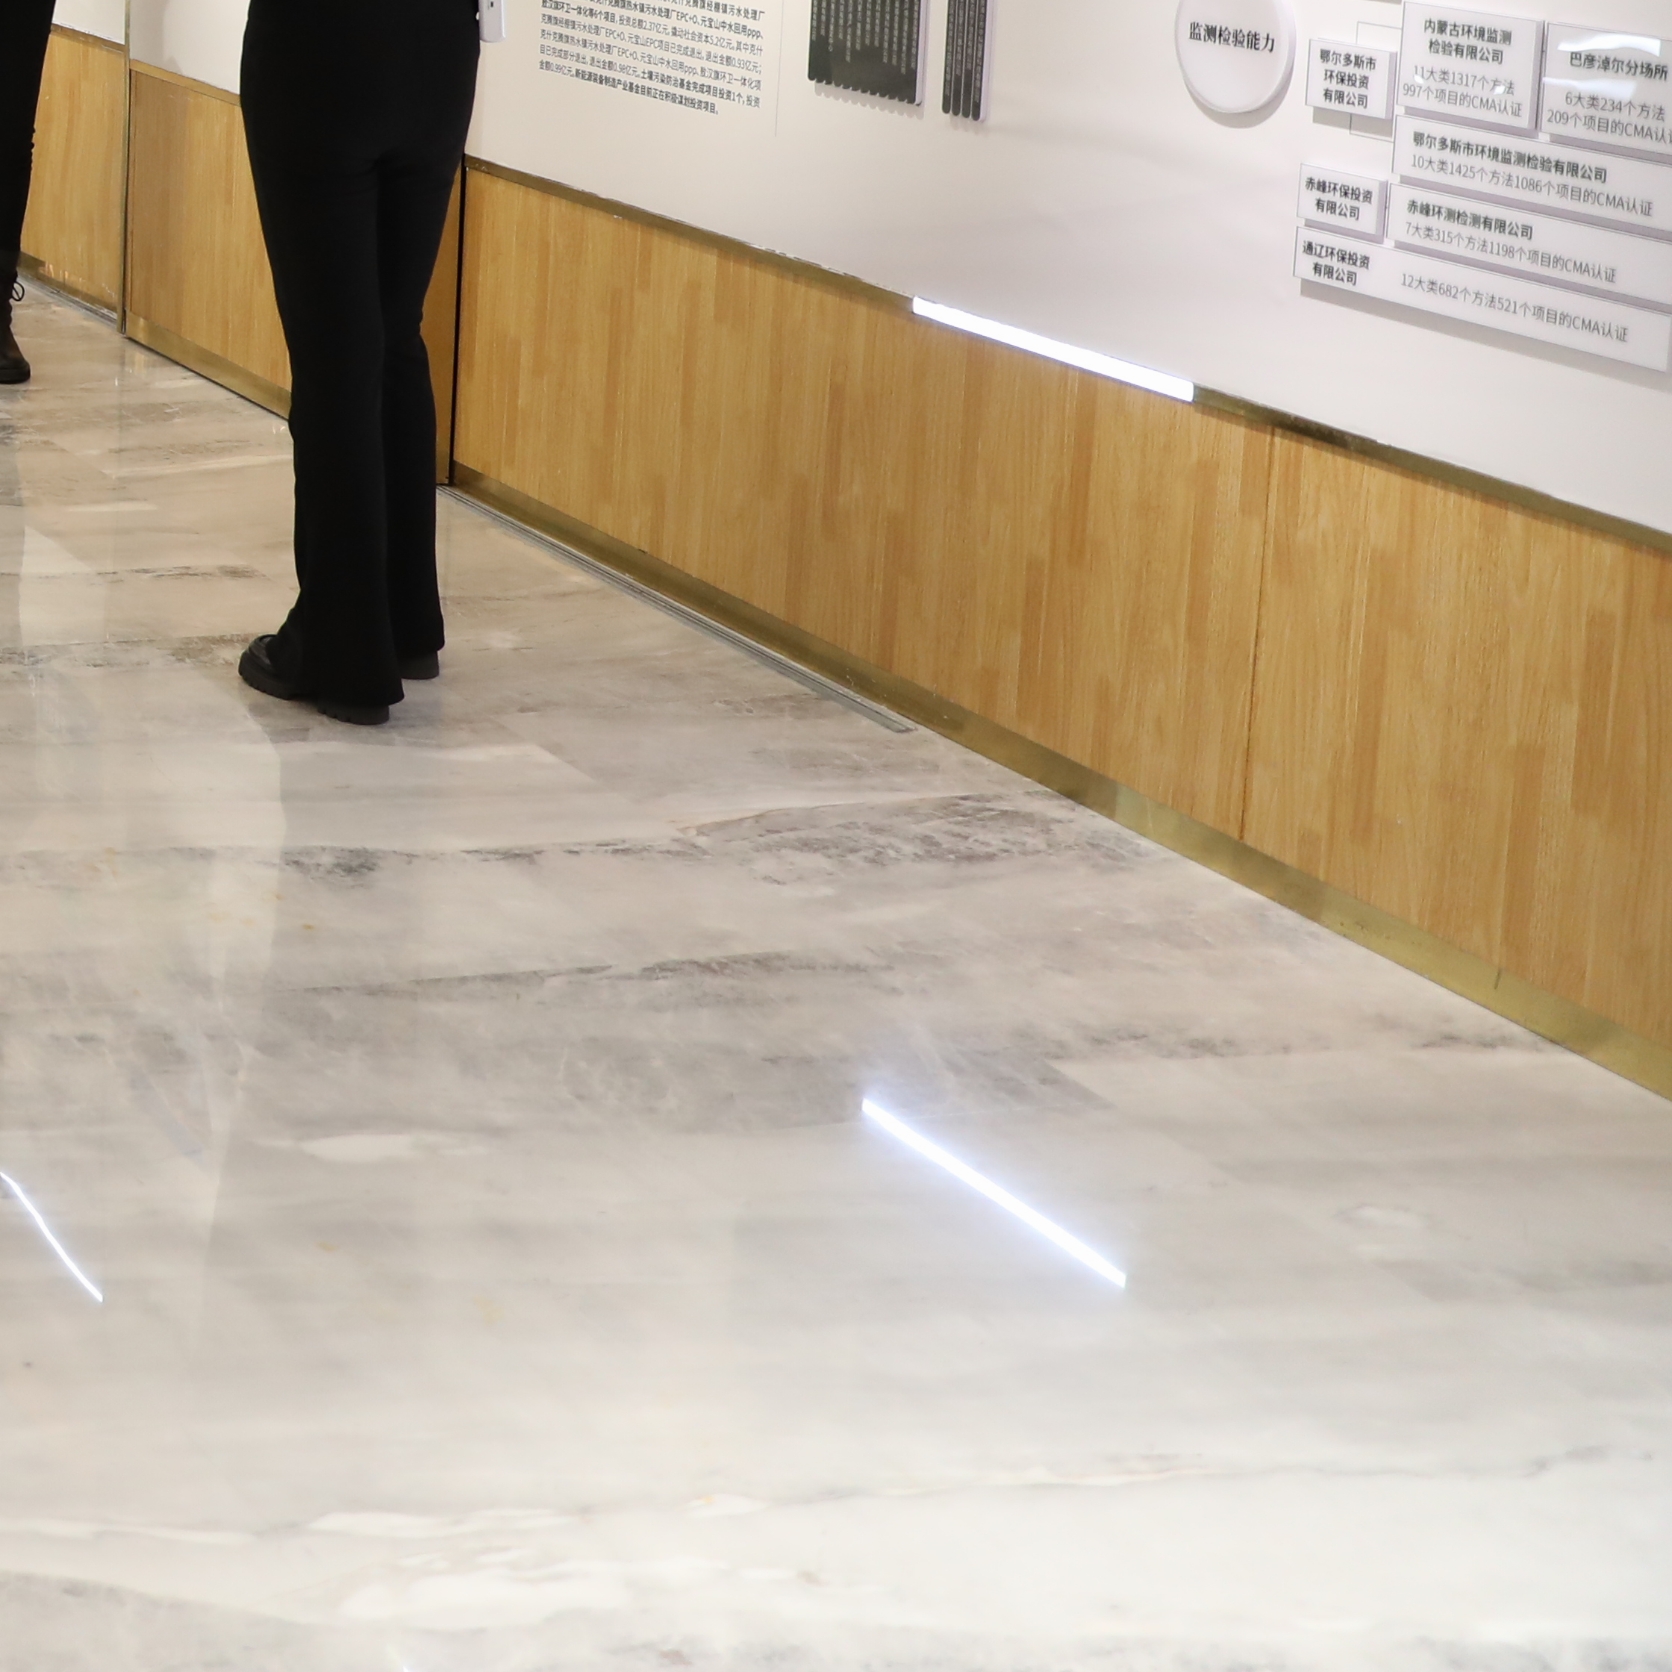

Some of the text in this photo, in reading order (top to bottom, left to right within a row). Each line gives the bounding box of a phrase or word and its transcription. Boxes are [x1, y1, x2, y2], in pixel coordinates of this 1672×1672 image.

[1189, 22, 1276, 53] 监测检验能力
[1424, 18, 1512, 45] 内蒙古环境监测
[1319, 49, 1377, 71] 鄂尔多斯市
[1429, 40, 1504, 65] 检验有限公司
[1323, 68, 1370, 90] 环保投资
[1322, 90, 1369, 109] 有限公司
[1403, 83, 1523, 118] 997个项目的CMA认证
[1565, 91, 1666, 122] 6大类234个方法
[1413, 131, 1607, 183] 鄂尔多斯市环境监测检验有限公司
[1305, 176, 1373, 205] 赤峰环保投资
[1315, 198, 1361, 221] 有限公司
[1407, 199, 1534, 240] 赤峰环测检测有限公司
[1302, 239, 1371, 271] 通辽环保投资
[1312, 263, 1358, 286] 有限公司
[1401, 273, 1629, 343] 12大类682个方法521个项目的CMA认证
